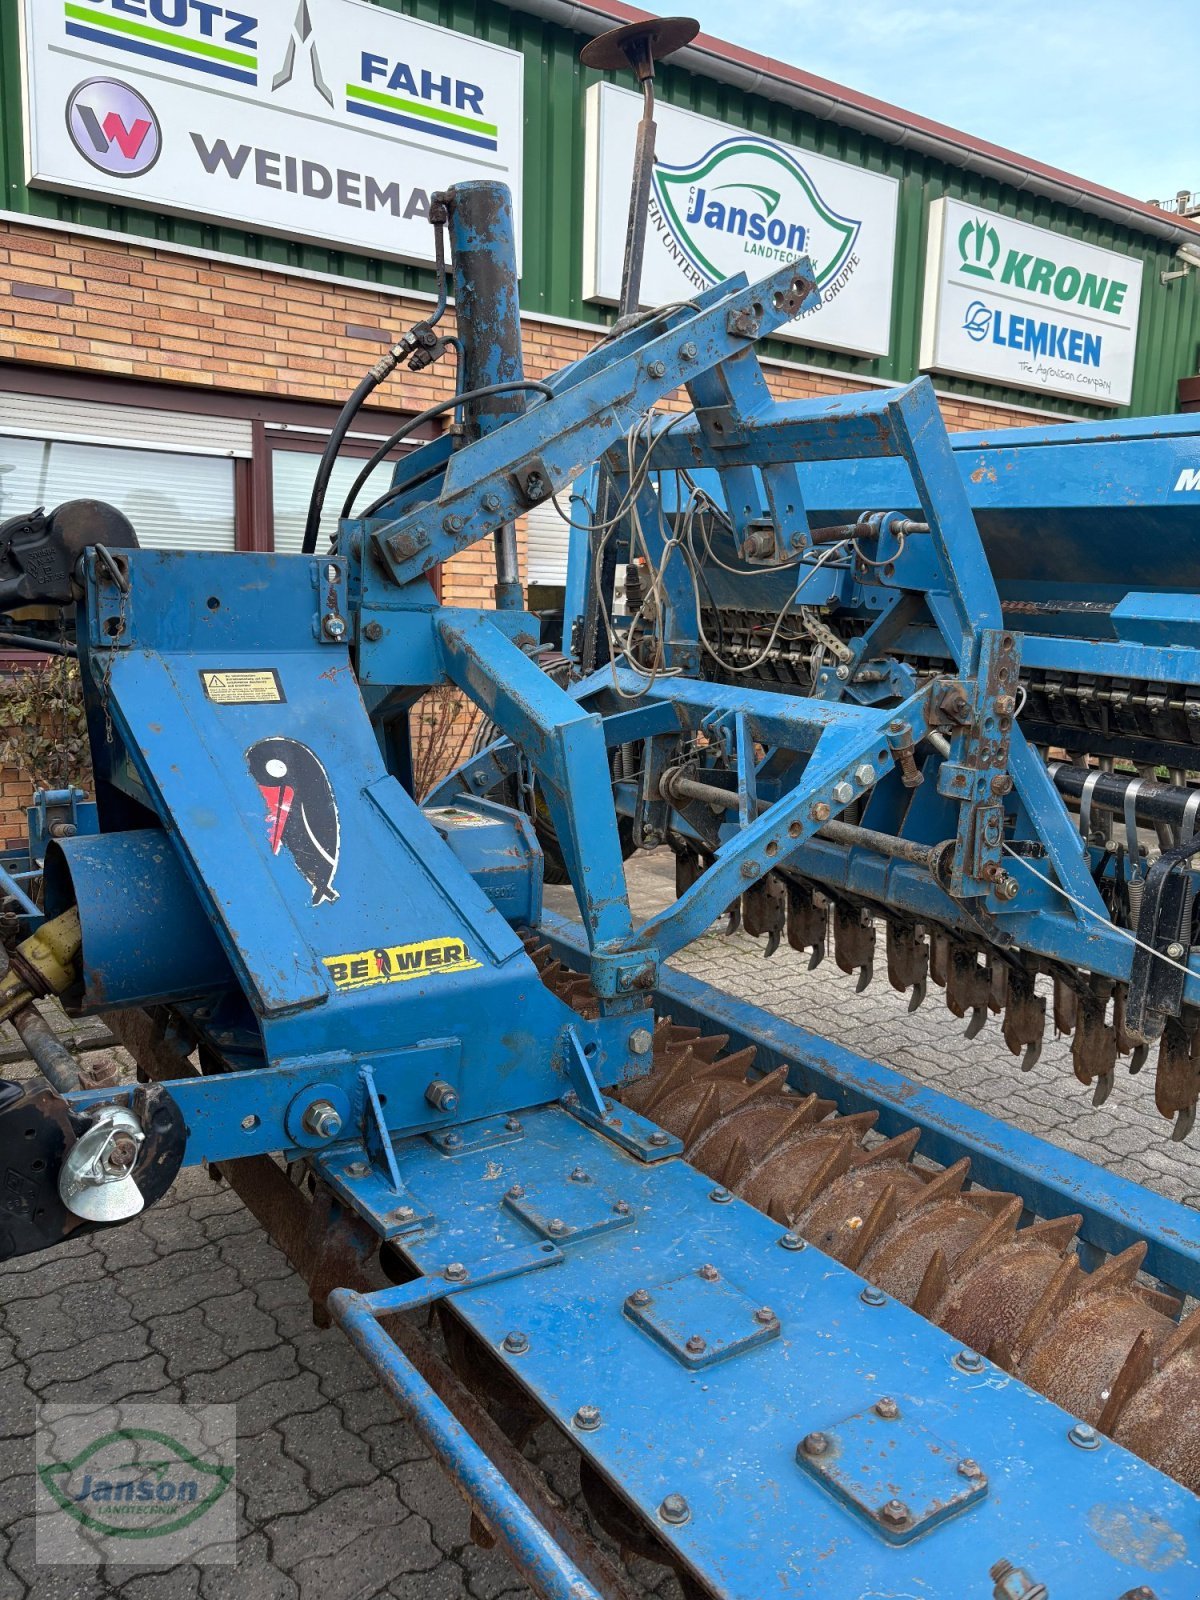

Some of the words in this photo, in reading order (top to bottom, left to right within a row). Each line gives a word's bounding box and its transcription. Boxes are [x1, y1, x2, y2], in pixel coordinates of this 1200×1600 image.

[361, 51, 484, 115] FAHR
[648, 198, 666, 232] EIN
[662, 231, 711, 292] UNTERN
[686, 188, 806, 252] Janson
[1000, 249, 1128, 314] KRONE
[992, 310, 1102, 367] LEMKEN
[1018, 361, 1033, 373] The
[1076, 374, 1111, 394] Company
